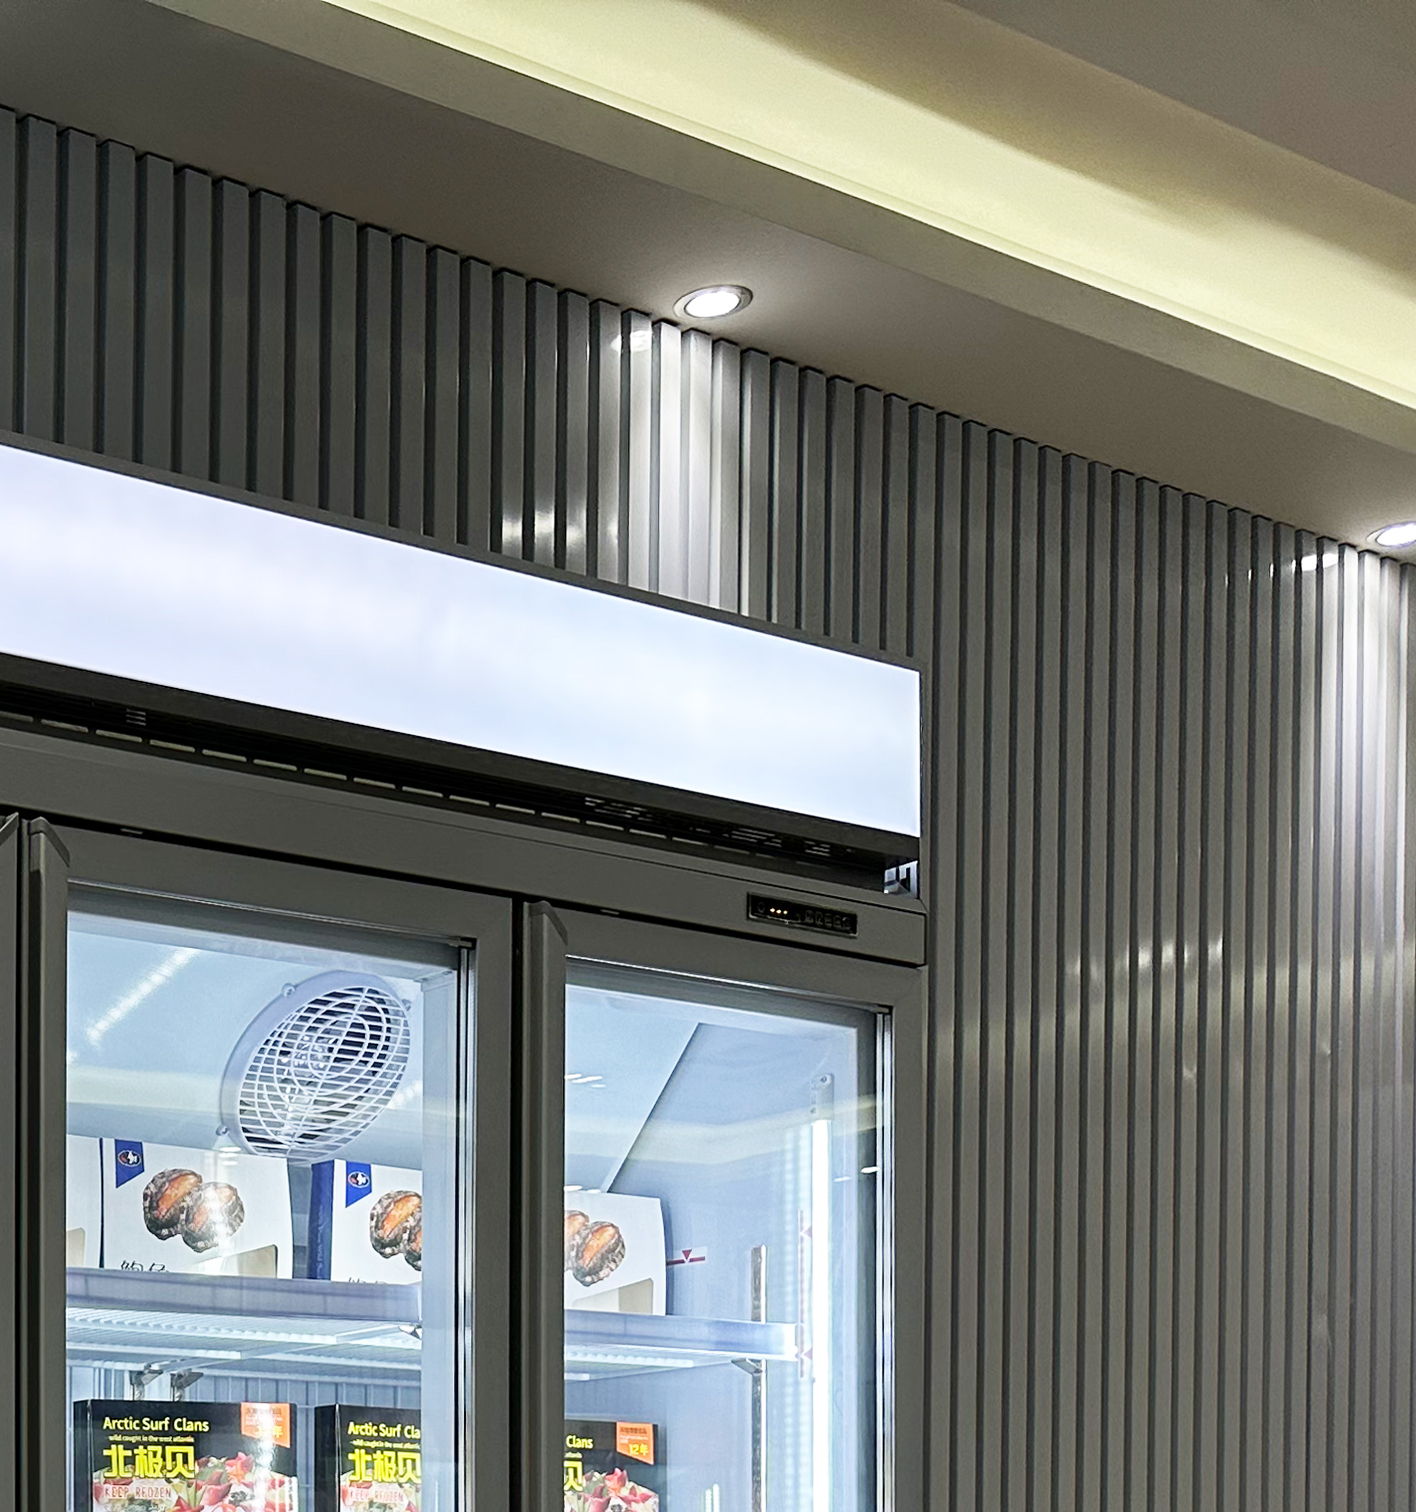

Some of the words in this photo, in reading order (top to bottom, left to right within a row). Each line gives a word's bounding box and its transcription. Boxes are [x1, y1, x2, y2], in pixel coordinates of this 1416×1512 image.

[103, 1416, 140, 1430] Arctic
[142, 1417, 170, 1431] Surf
[174, 1417, 209, 1432] Clans
[348, 1421, 378, 1437] Arctic
[379, 1423, 402, 1438] Surf
[566, 1435, 593, 1449] Clans
[103, 1444, 195, 1478] 北极贝
[348, 1449, 421, 1483] 北极贝
